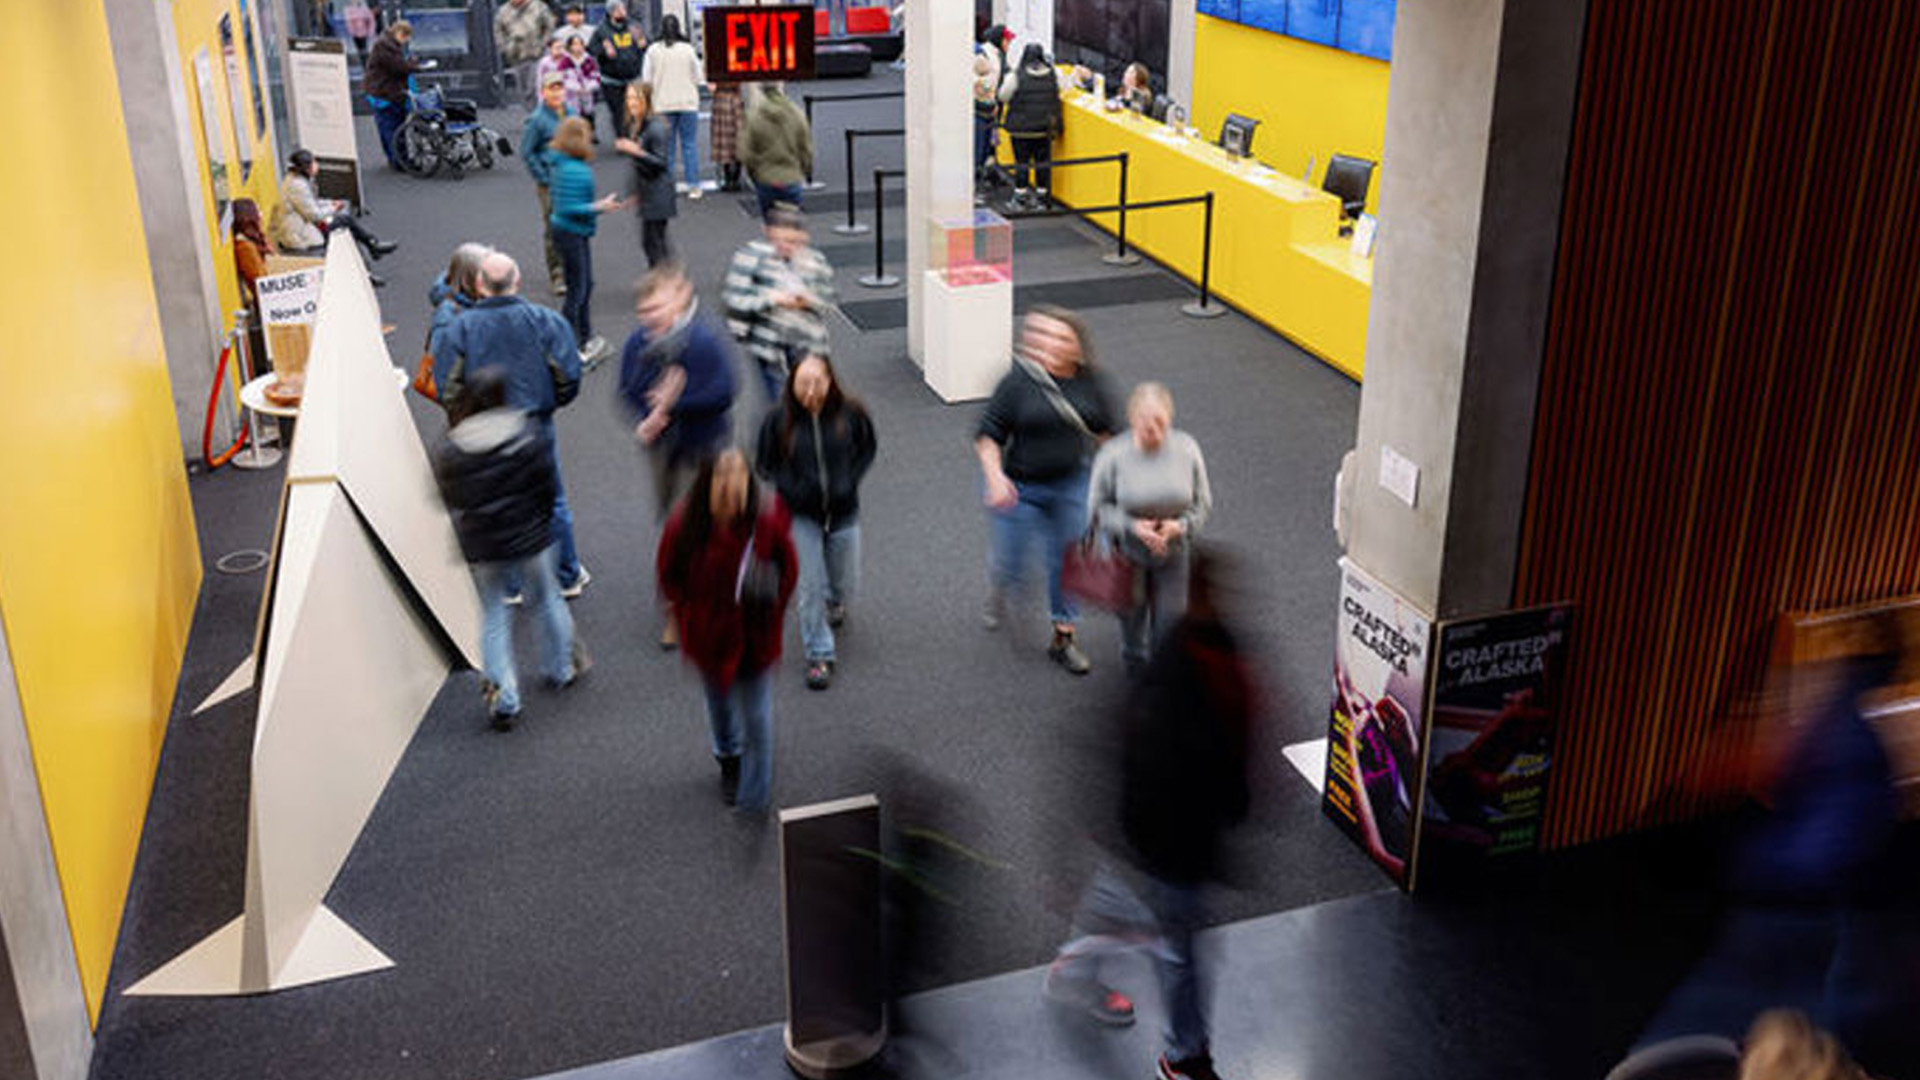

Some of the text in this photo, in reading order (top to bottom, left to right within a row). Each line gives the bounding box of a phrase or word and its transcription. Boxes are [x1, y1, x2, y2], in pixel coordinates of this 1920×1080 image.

[726, 12, 800, 71] EXIT
[270, 306, 302, 320] Now
[1343, 596, 1412, 657] CRAFTED
[1352, 622, 1408, 677] ALASKA
[1445, 635, 1549, 669] CRAFTED
[1459, 655, 1544, 686] ALASKA
